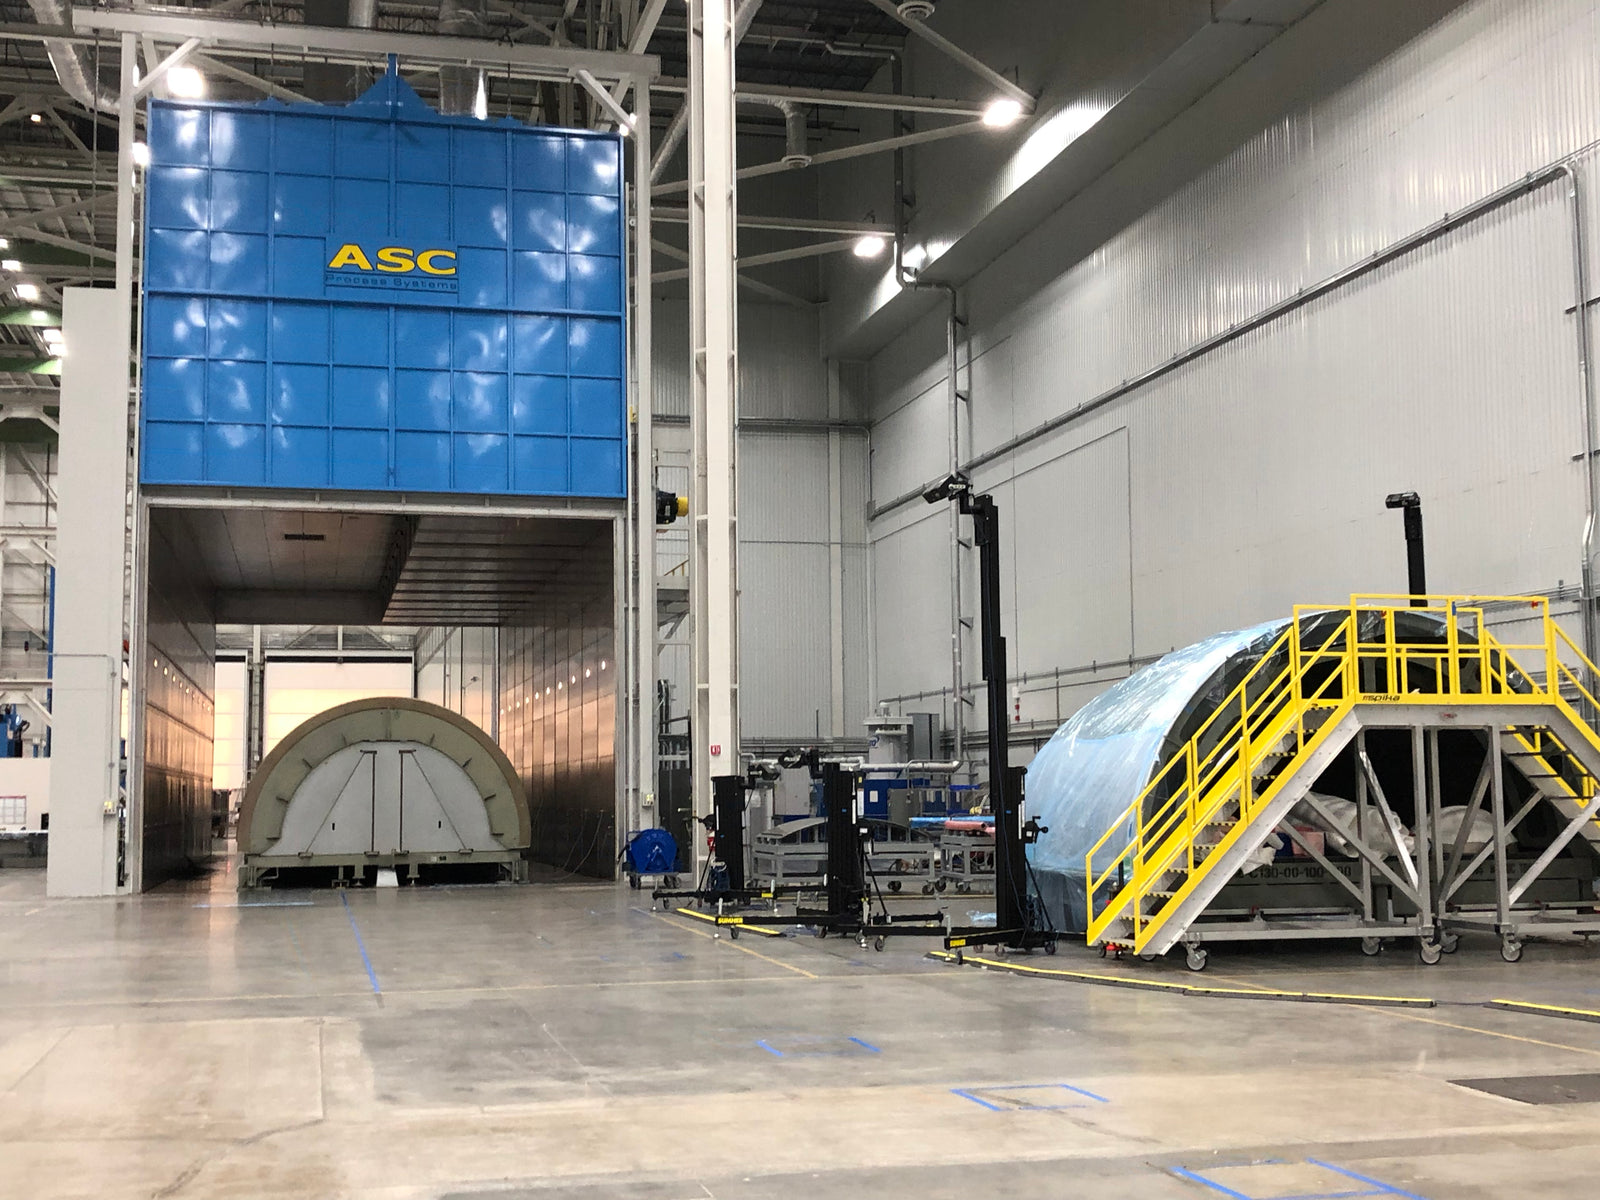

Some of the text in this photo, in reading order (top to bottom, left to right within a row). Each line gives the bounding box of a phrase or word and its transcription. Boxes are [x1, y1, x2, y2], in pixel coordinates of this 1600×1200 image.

[327, 243, 457, 275] ASC
[325, 274, 457, 290] Process Systems
